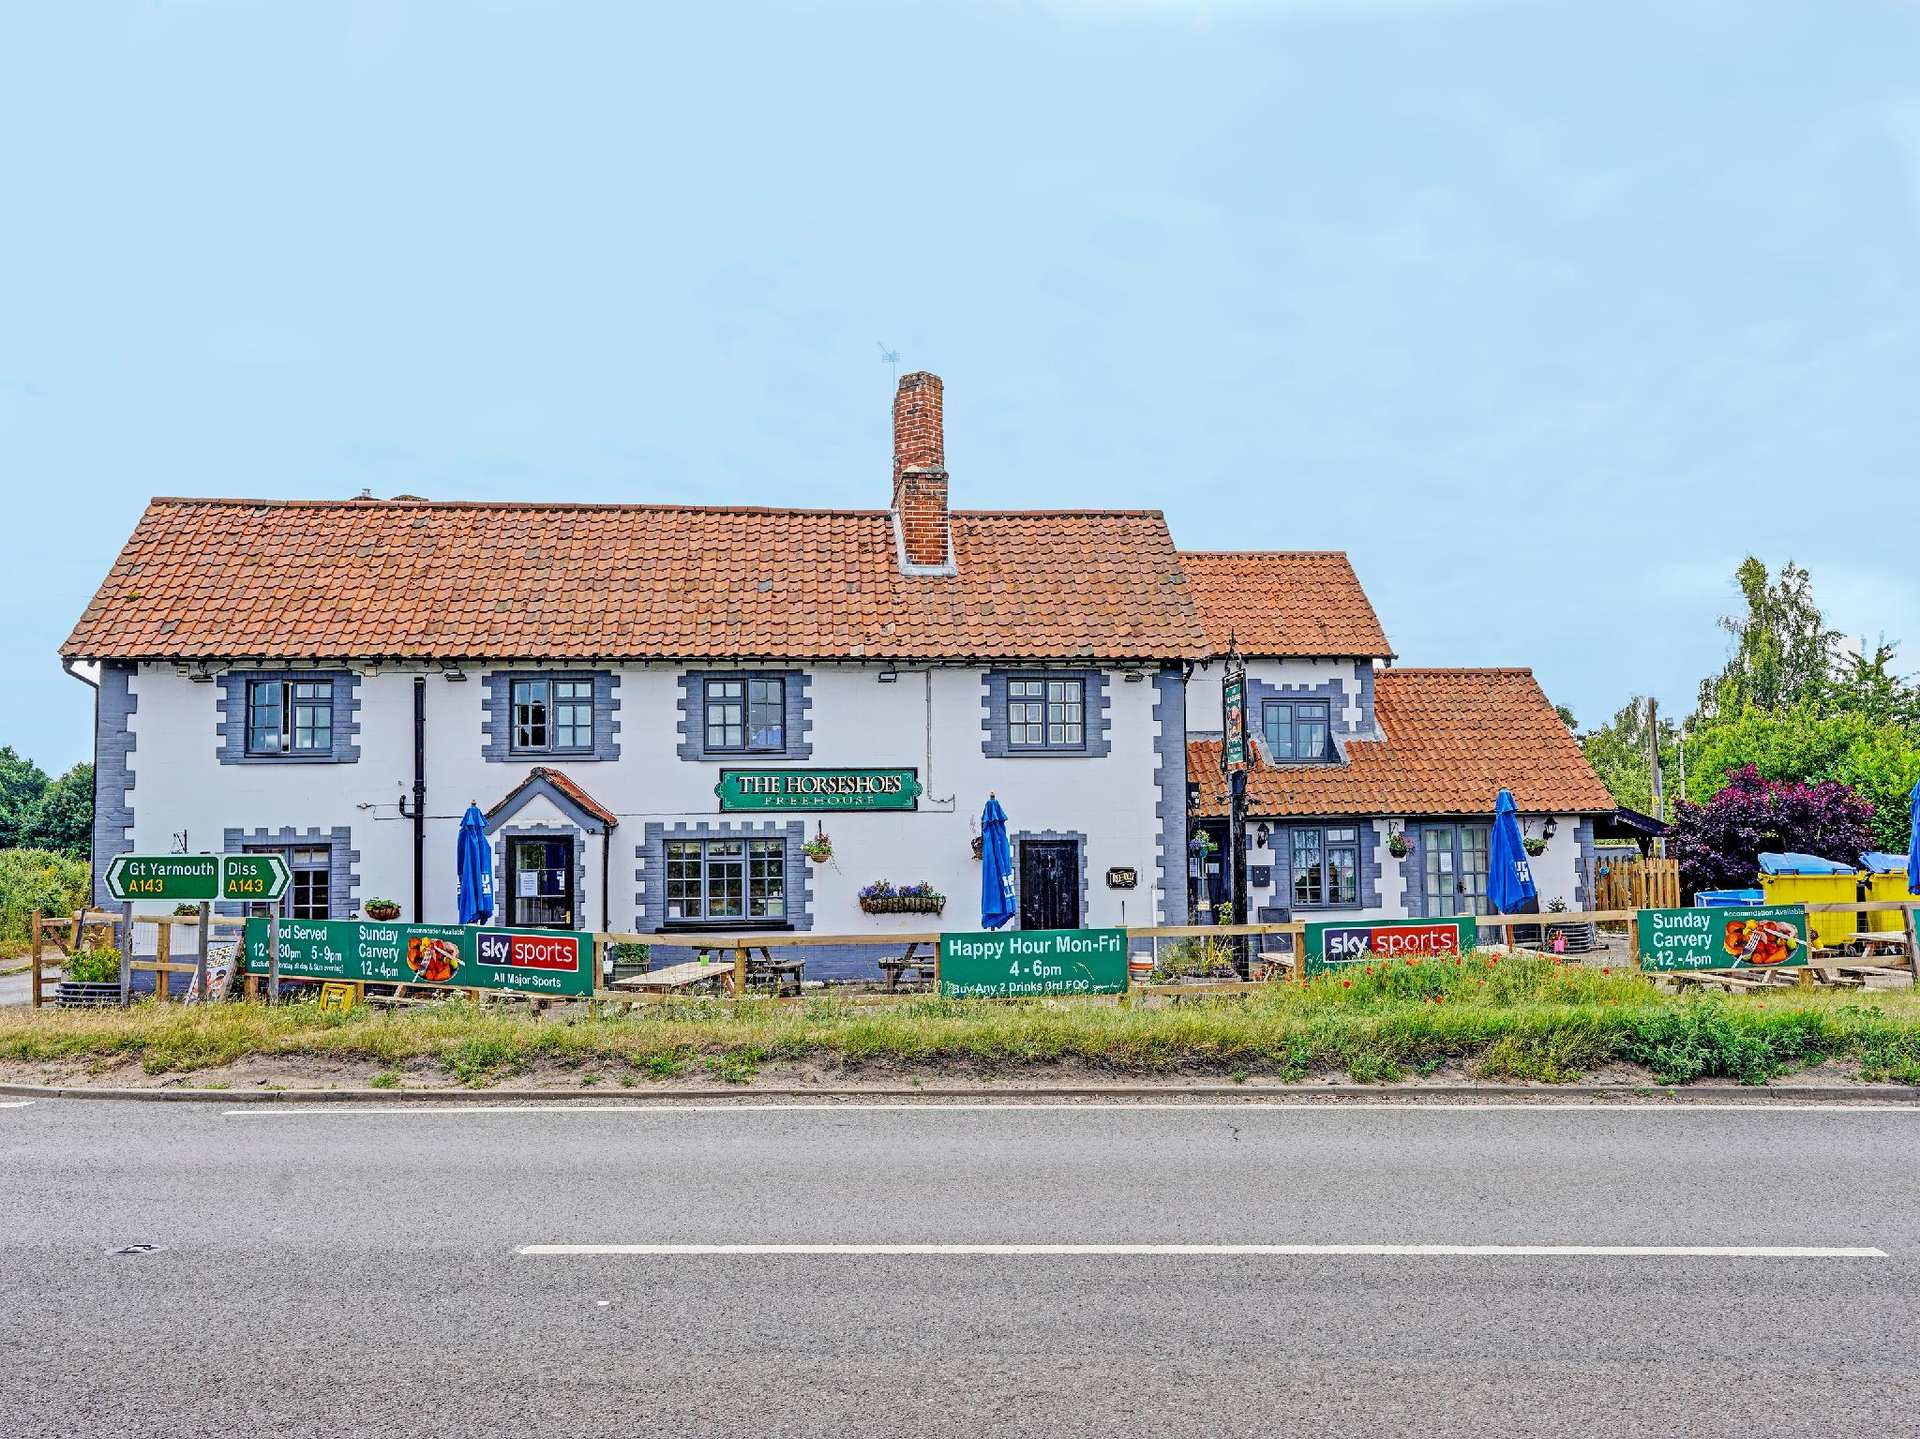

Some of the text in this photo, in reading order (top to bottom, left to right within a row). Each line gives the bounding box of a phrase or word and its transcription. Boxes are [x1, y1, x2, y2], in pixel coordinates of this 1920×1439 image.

[738, 776, 902, 795] THE HORSESHOES
[764, 796, 875, 806] FREEHOUSE
[129, 862, 215, 876] Gt Yarmouth
[228, 862, 258, 876] Diss
[128, 879, 164, 893] A143
[228, 879, 264, 893] A143
[1653, 913, 1711, 931] Sunday
[267, 925, 328, 941] Fod Served
[359, 925, 399, 945] Sunday
[1653, 933, 1712, 950] Carvery
[482, 937, 573, 965] sky sports
[949, 935, 1121, 960] Happy Hour Mon-Fri
[1330, 930, 1452, 958] sky sports
[358, 943, 400, 964] Carvery
[1656, 951, 1675, 966] 12
[1685, 950, 1712, 969] 4pm
[360, 960, 372, 976] 12
[380, 962, 399, 979] 4pm
[1009, 960, 1020, 977] 4
[1033, 959, 1062, 978] 6pm
[493, 972, 561, 988] All Major Sports
[975, 982, 997, 995] Any
[1000, 982, 1007, 992] 2
[1009, 980, 1043, 992] Drinks
[1045, 980, 1063, 991] 3rd
